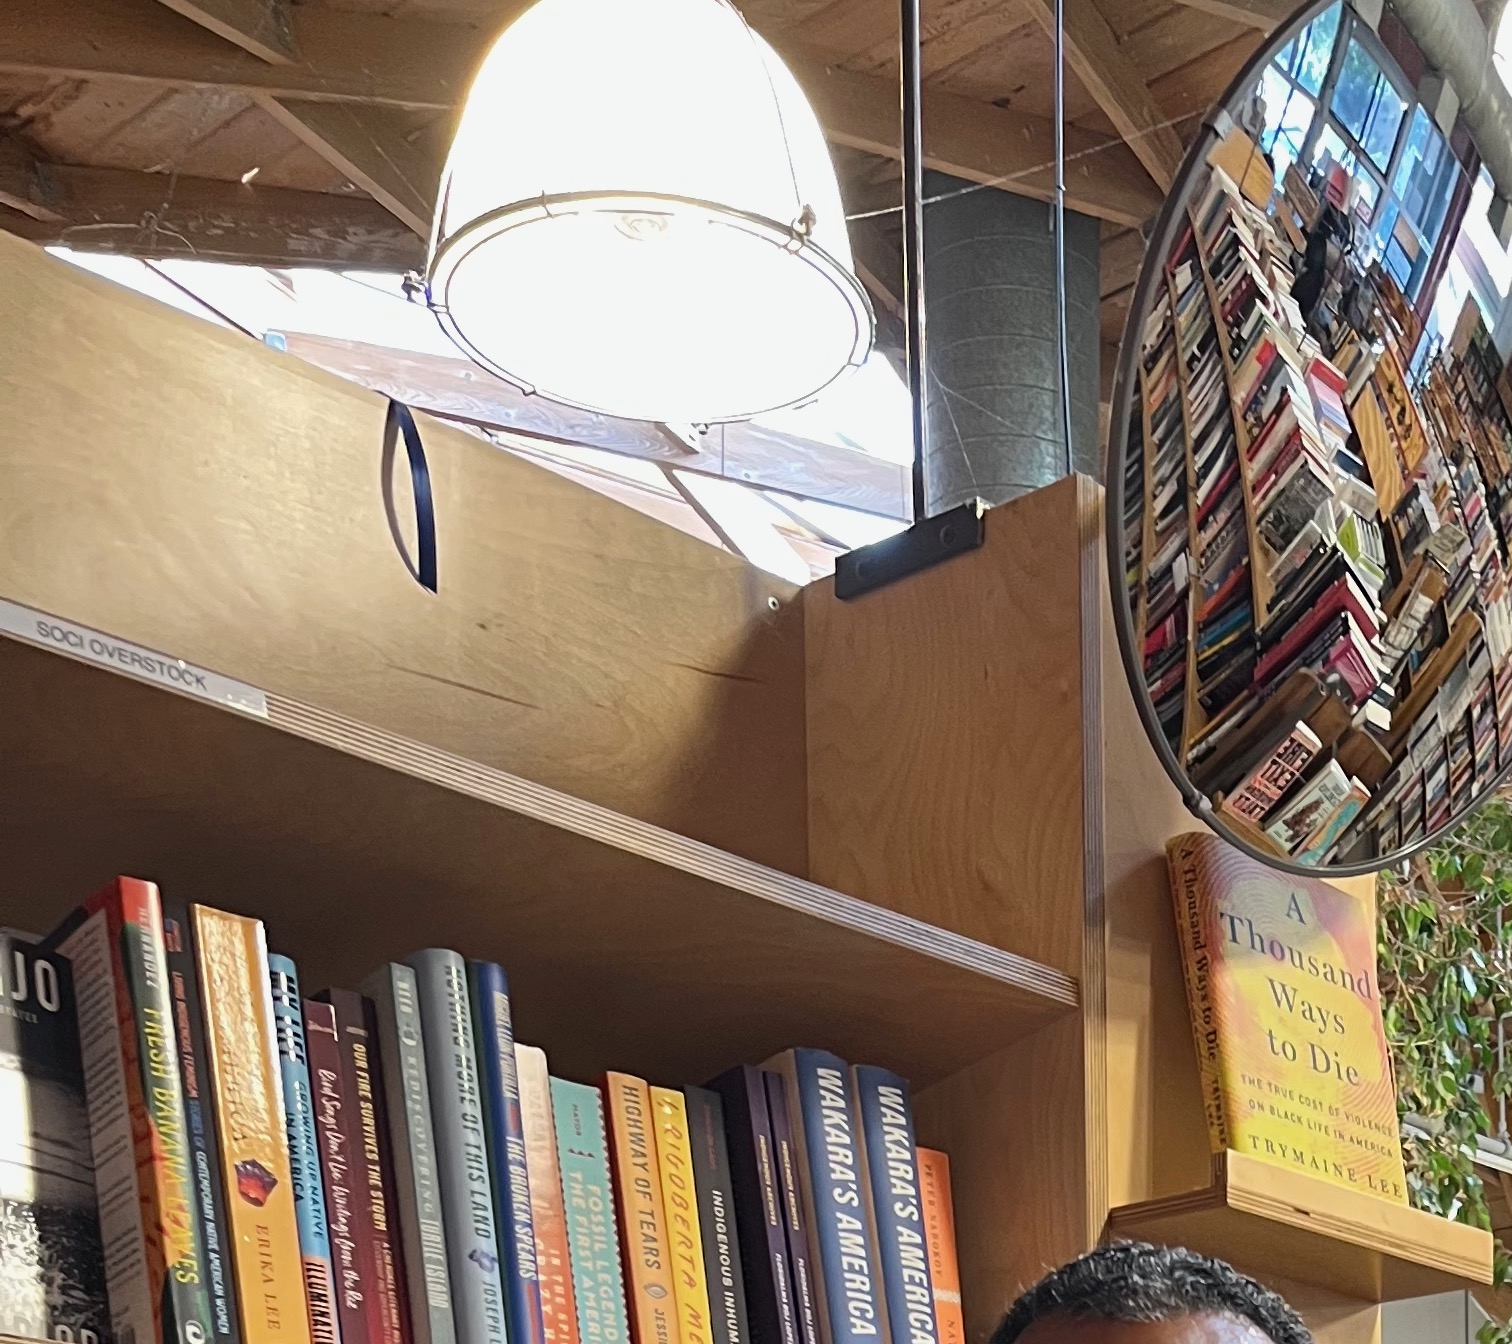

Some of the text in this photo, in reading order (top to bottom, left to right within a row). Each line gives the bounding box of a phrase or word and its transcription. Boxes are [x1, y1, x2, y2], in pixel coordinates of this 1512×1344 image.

[36, 620, 208, 692] SOCI OVERSTOCK
[1285, 891, 1307, 925] A
[1219, 910, 1374, 1001] Thousand
[1266, 976, 1346, 1036] Ways
[1266, 1028, 1361, 1087] to Die
[816, 1067, 859, 1208] WAKARA'S
[1240, 1073, 1395, 1138] THE TRUE COST OF VIOLENCE
[1248, 1098, 1394, 1159] ON BLACK LIFE IN AMERICA
[622, 1085, 661, 1271] HIGHWAY OF TEARS
[877, 1085, 920, 1222] WAKARA'S
[1247, 1134, 1404, 1200] TRYMAINE LEE
[663, 1124, 697, 1290] RIGOBERTA
[712, 1189, 734, 1289] INDIGENOUS
[256, 1223, 281, 1331] ERIKA LEE
[835, 1212, 877, 1336] AMERICA
